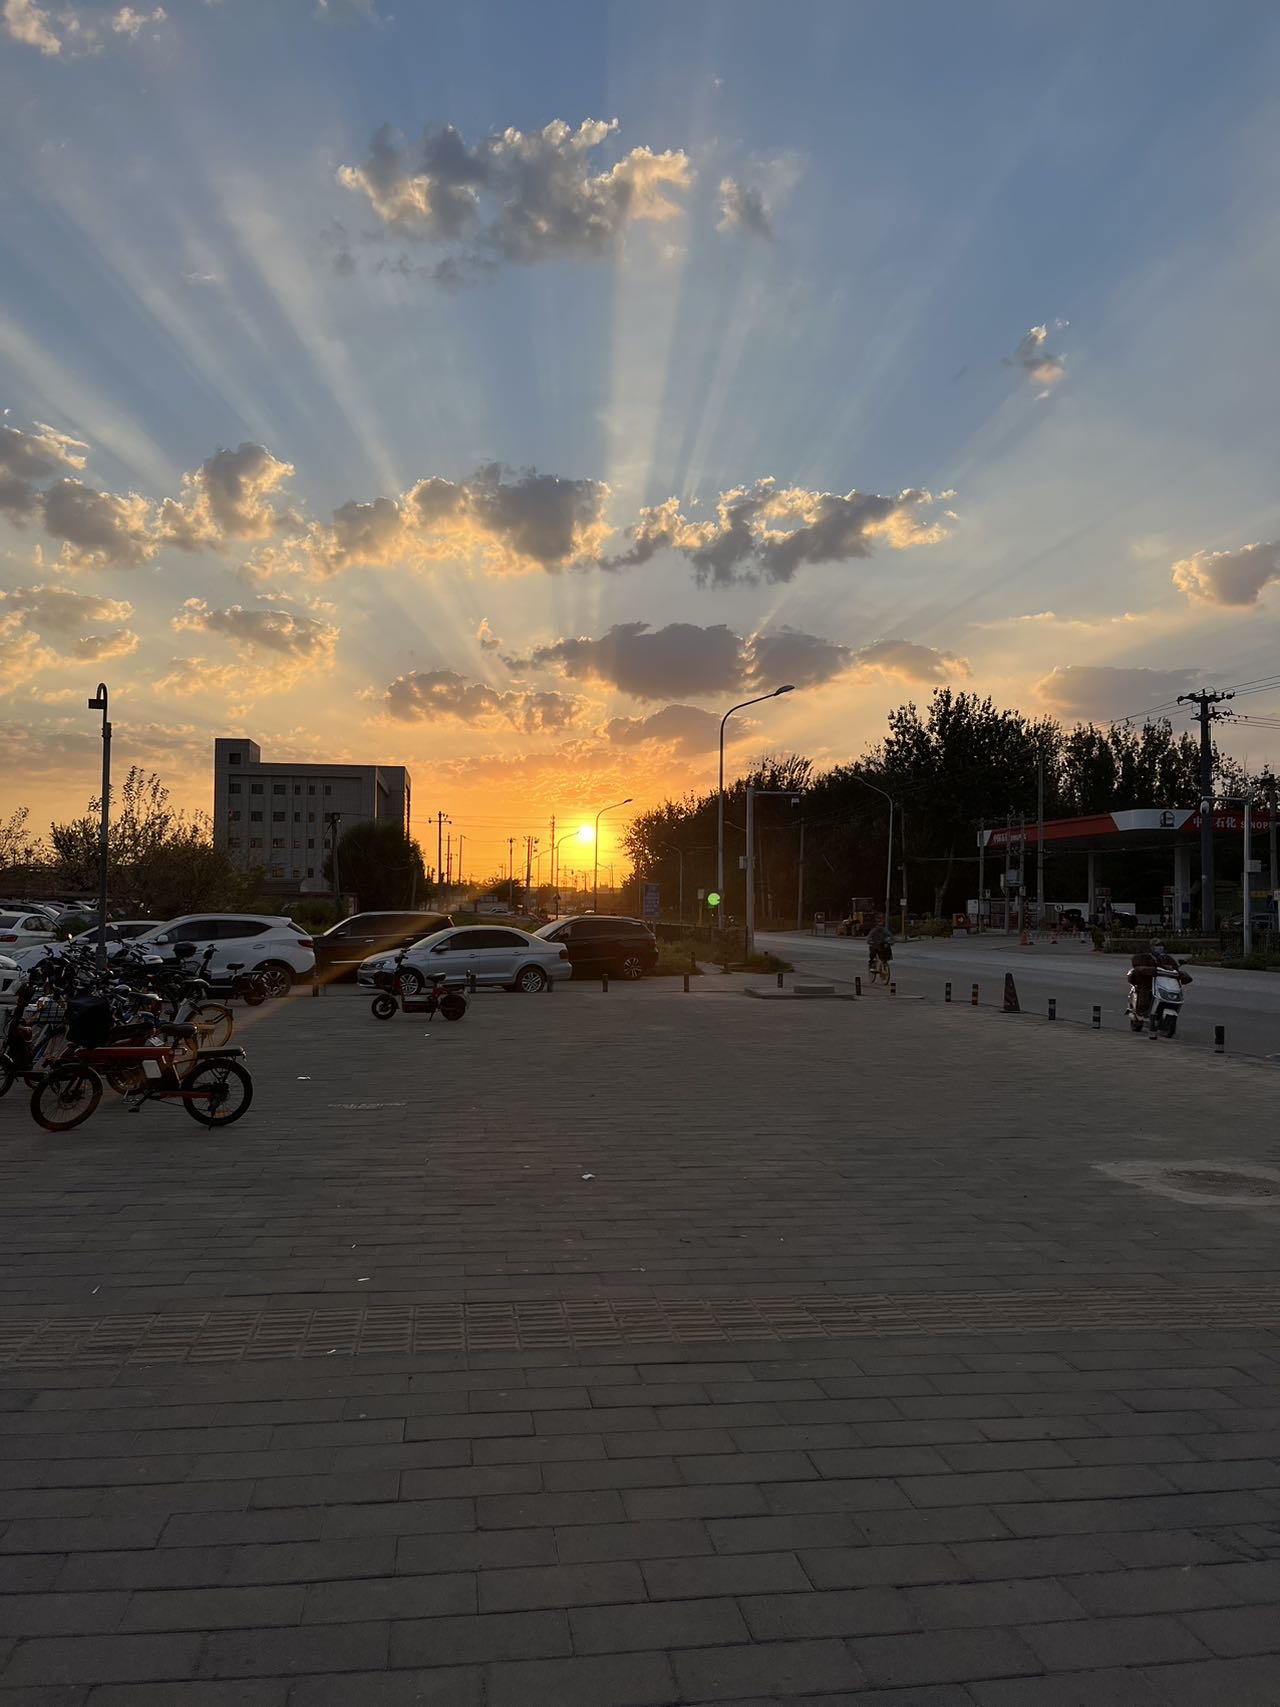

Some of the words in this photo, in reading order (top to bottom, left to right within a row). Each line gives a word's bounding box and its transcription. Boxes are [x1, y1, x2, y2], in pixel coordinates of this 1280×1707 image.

[1193, 816, 1237, 829] 中石化
[1240, 820, 1272, 830] SNOP
